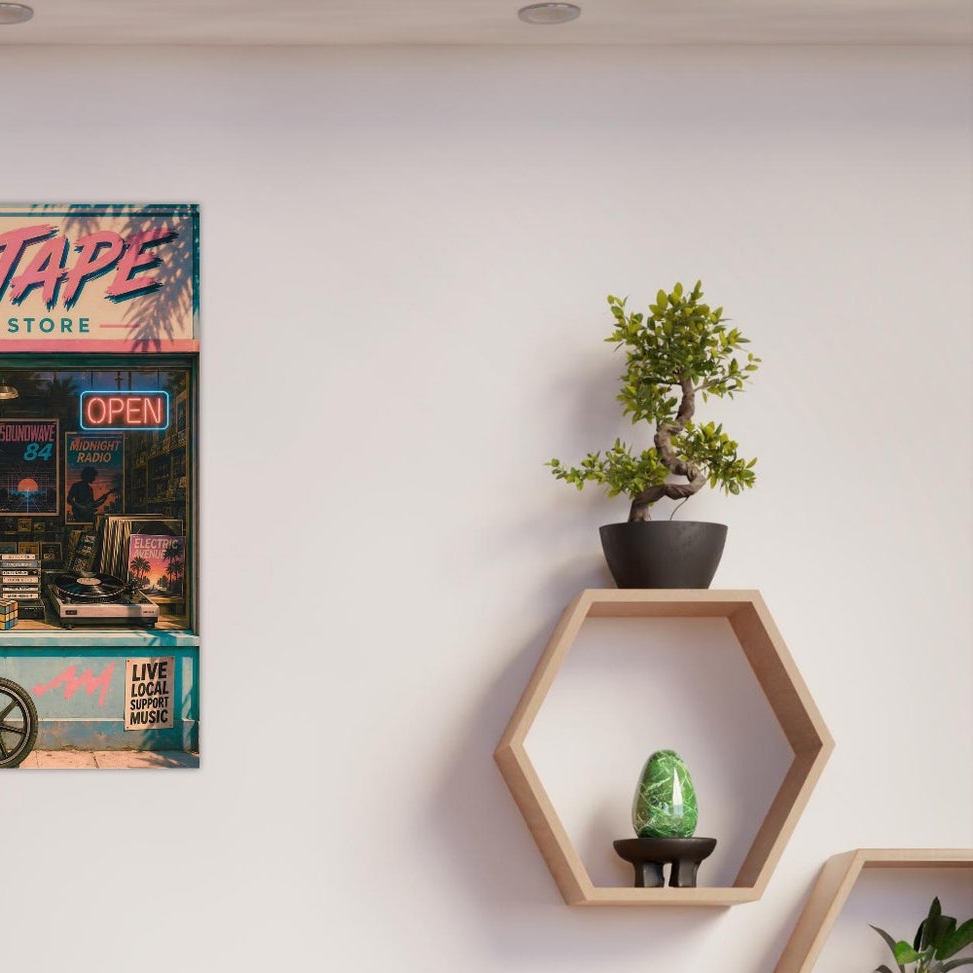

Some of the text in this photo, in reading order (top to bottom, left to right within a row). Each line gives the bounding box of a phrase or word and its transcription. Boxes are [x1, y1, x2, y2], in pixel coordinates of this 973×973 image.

[7, 317, 91, 333] STORE
[87, 397, 161, 424] OPEN
[69, 437, 121, 451] MIDNIGHT
[23, 443, 53, 461] 84
[76, 452, 112, 463] RADIO
[134, 538, 179, 550] ELECTRIC
[132, 662, 167, 681] LIVE
[131, 681, 169, 697] LOCAL
[130, 697, 169, 711] SUPPORT
[130, 710, 168, 725] MUSIC
